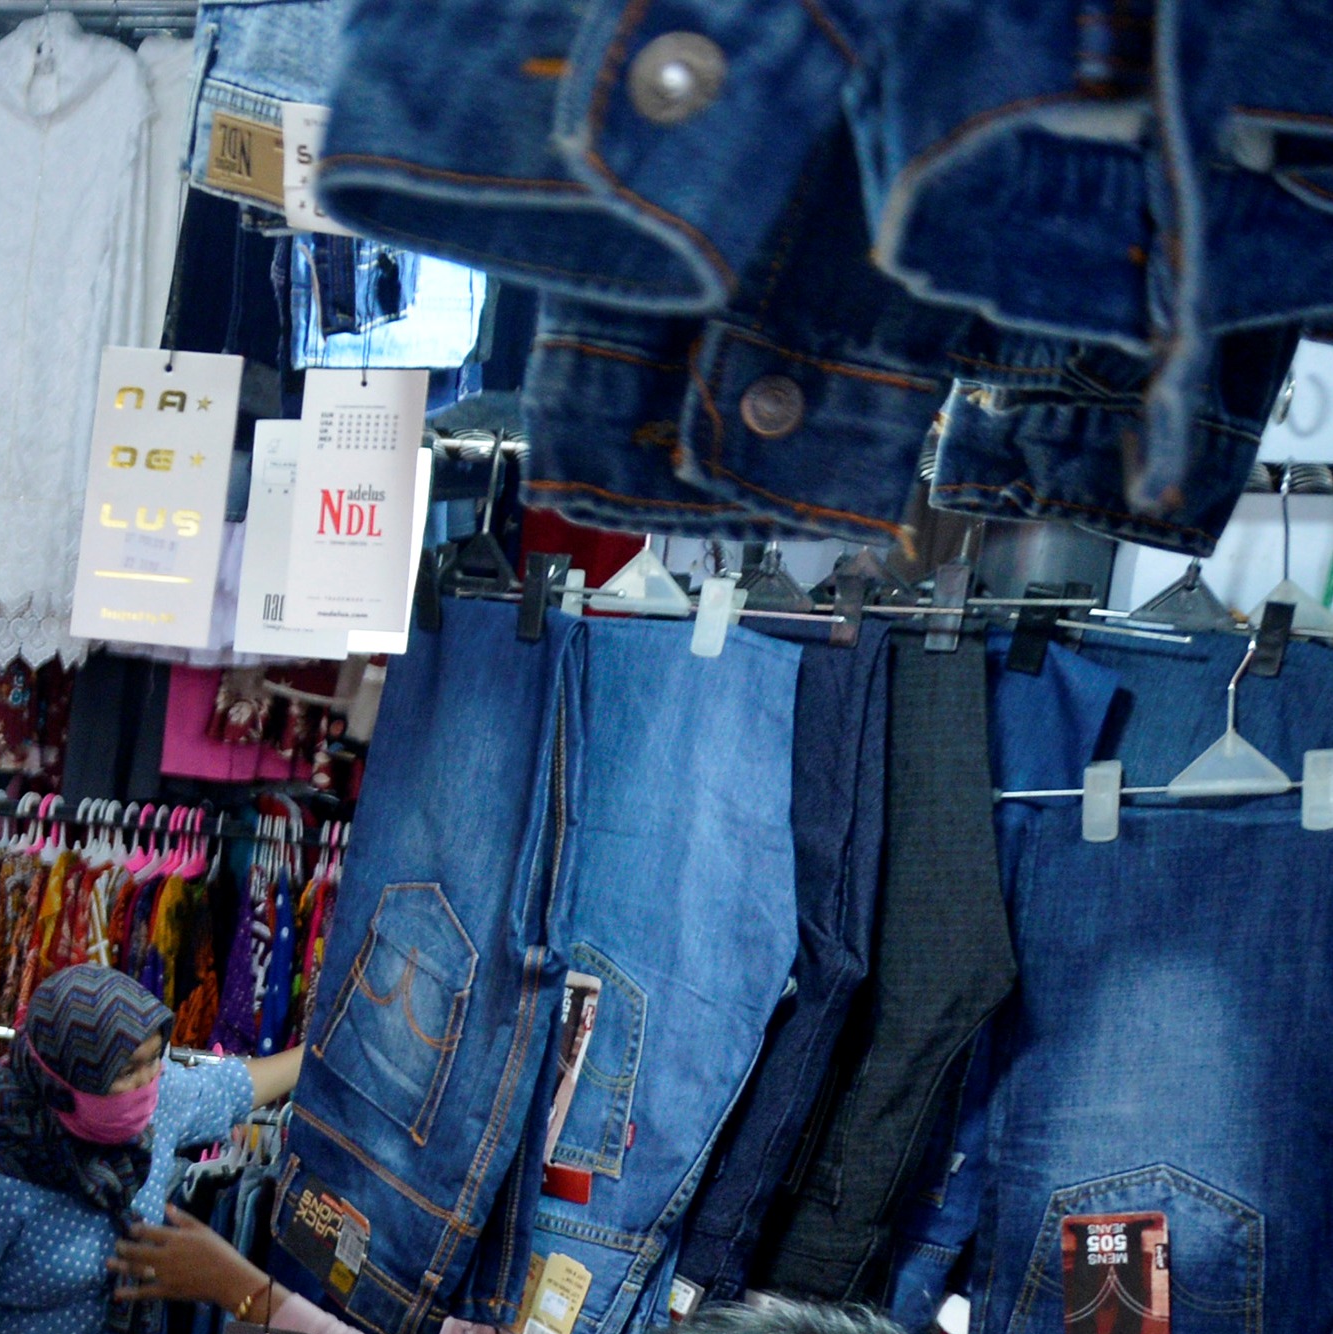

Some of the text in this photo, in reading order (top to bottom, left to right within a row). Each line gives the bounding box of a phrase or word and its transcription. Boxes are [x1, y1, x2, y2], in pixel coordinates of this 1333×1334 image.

[100, 503, 201, 537] LUS
[1087, 1223, 1127, 1234] JEANS
[1087, 1235, 1128, 1253] 505
[1087, 1252, 1128, 1266] MENS
